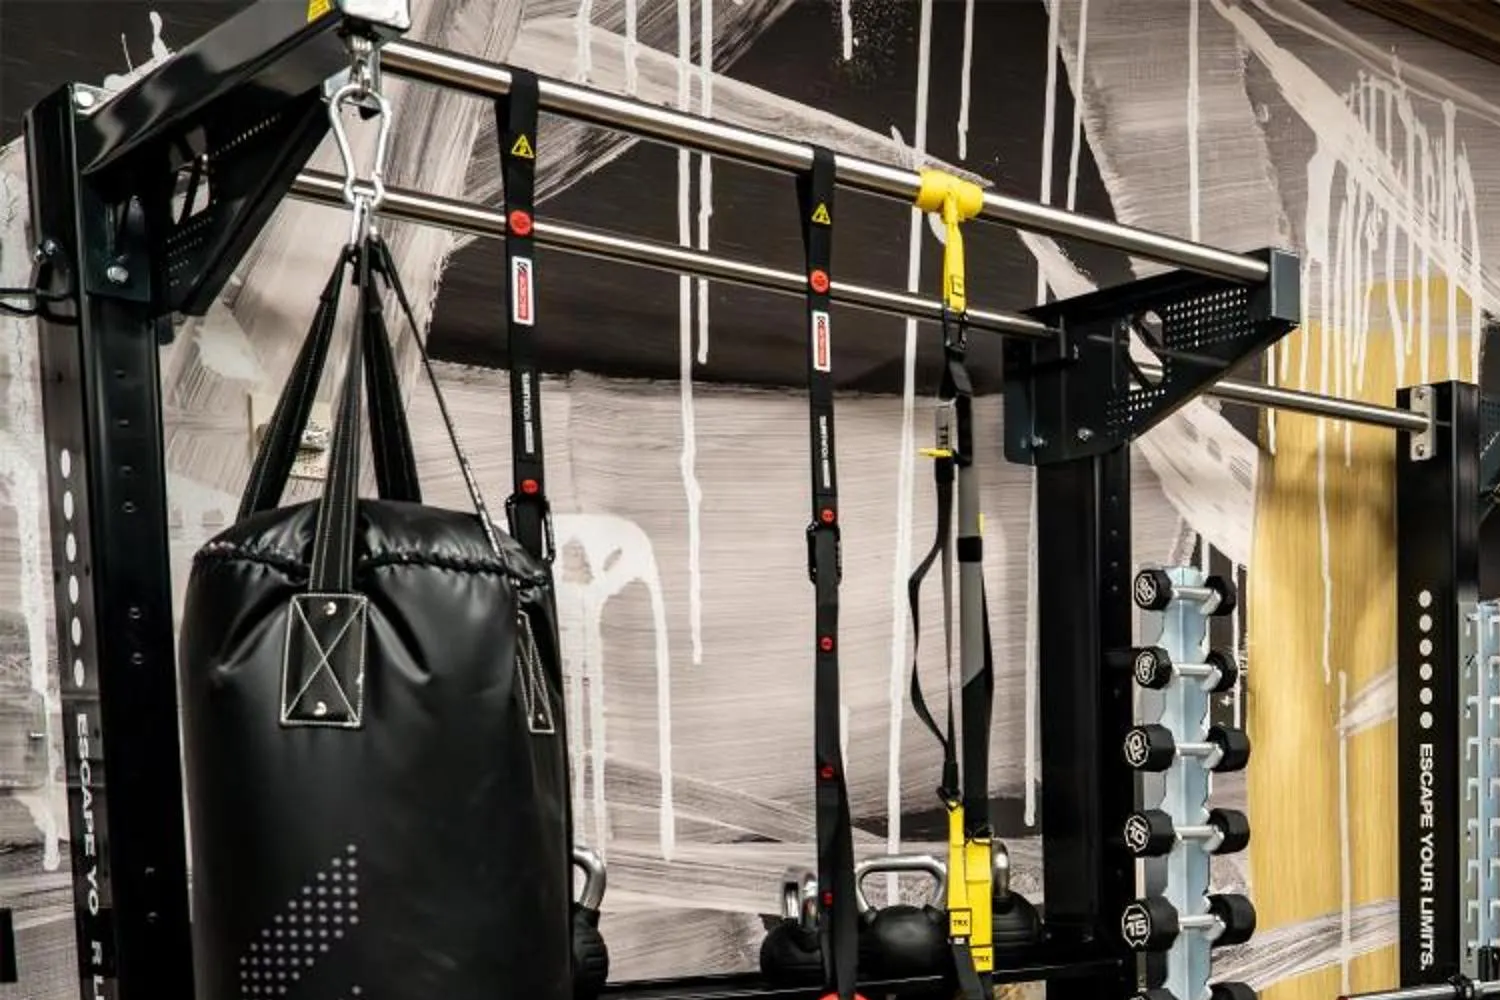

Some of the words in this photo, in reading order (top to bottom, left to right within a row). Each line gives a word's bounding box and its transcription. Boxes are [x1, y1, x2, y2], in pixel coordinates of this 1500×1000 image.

[77, 713, 97, 855] ESCAPE
[1419, 743, 1434, 828] ESCAPE
[1419, 832, 1434, 892] YOUR
[86, 867, 103, 965] YOR
[1125, 919, 1147, 937] 15
[1419, 897, 1434, 971] LIMITS.
